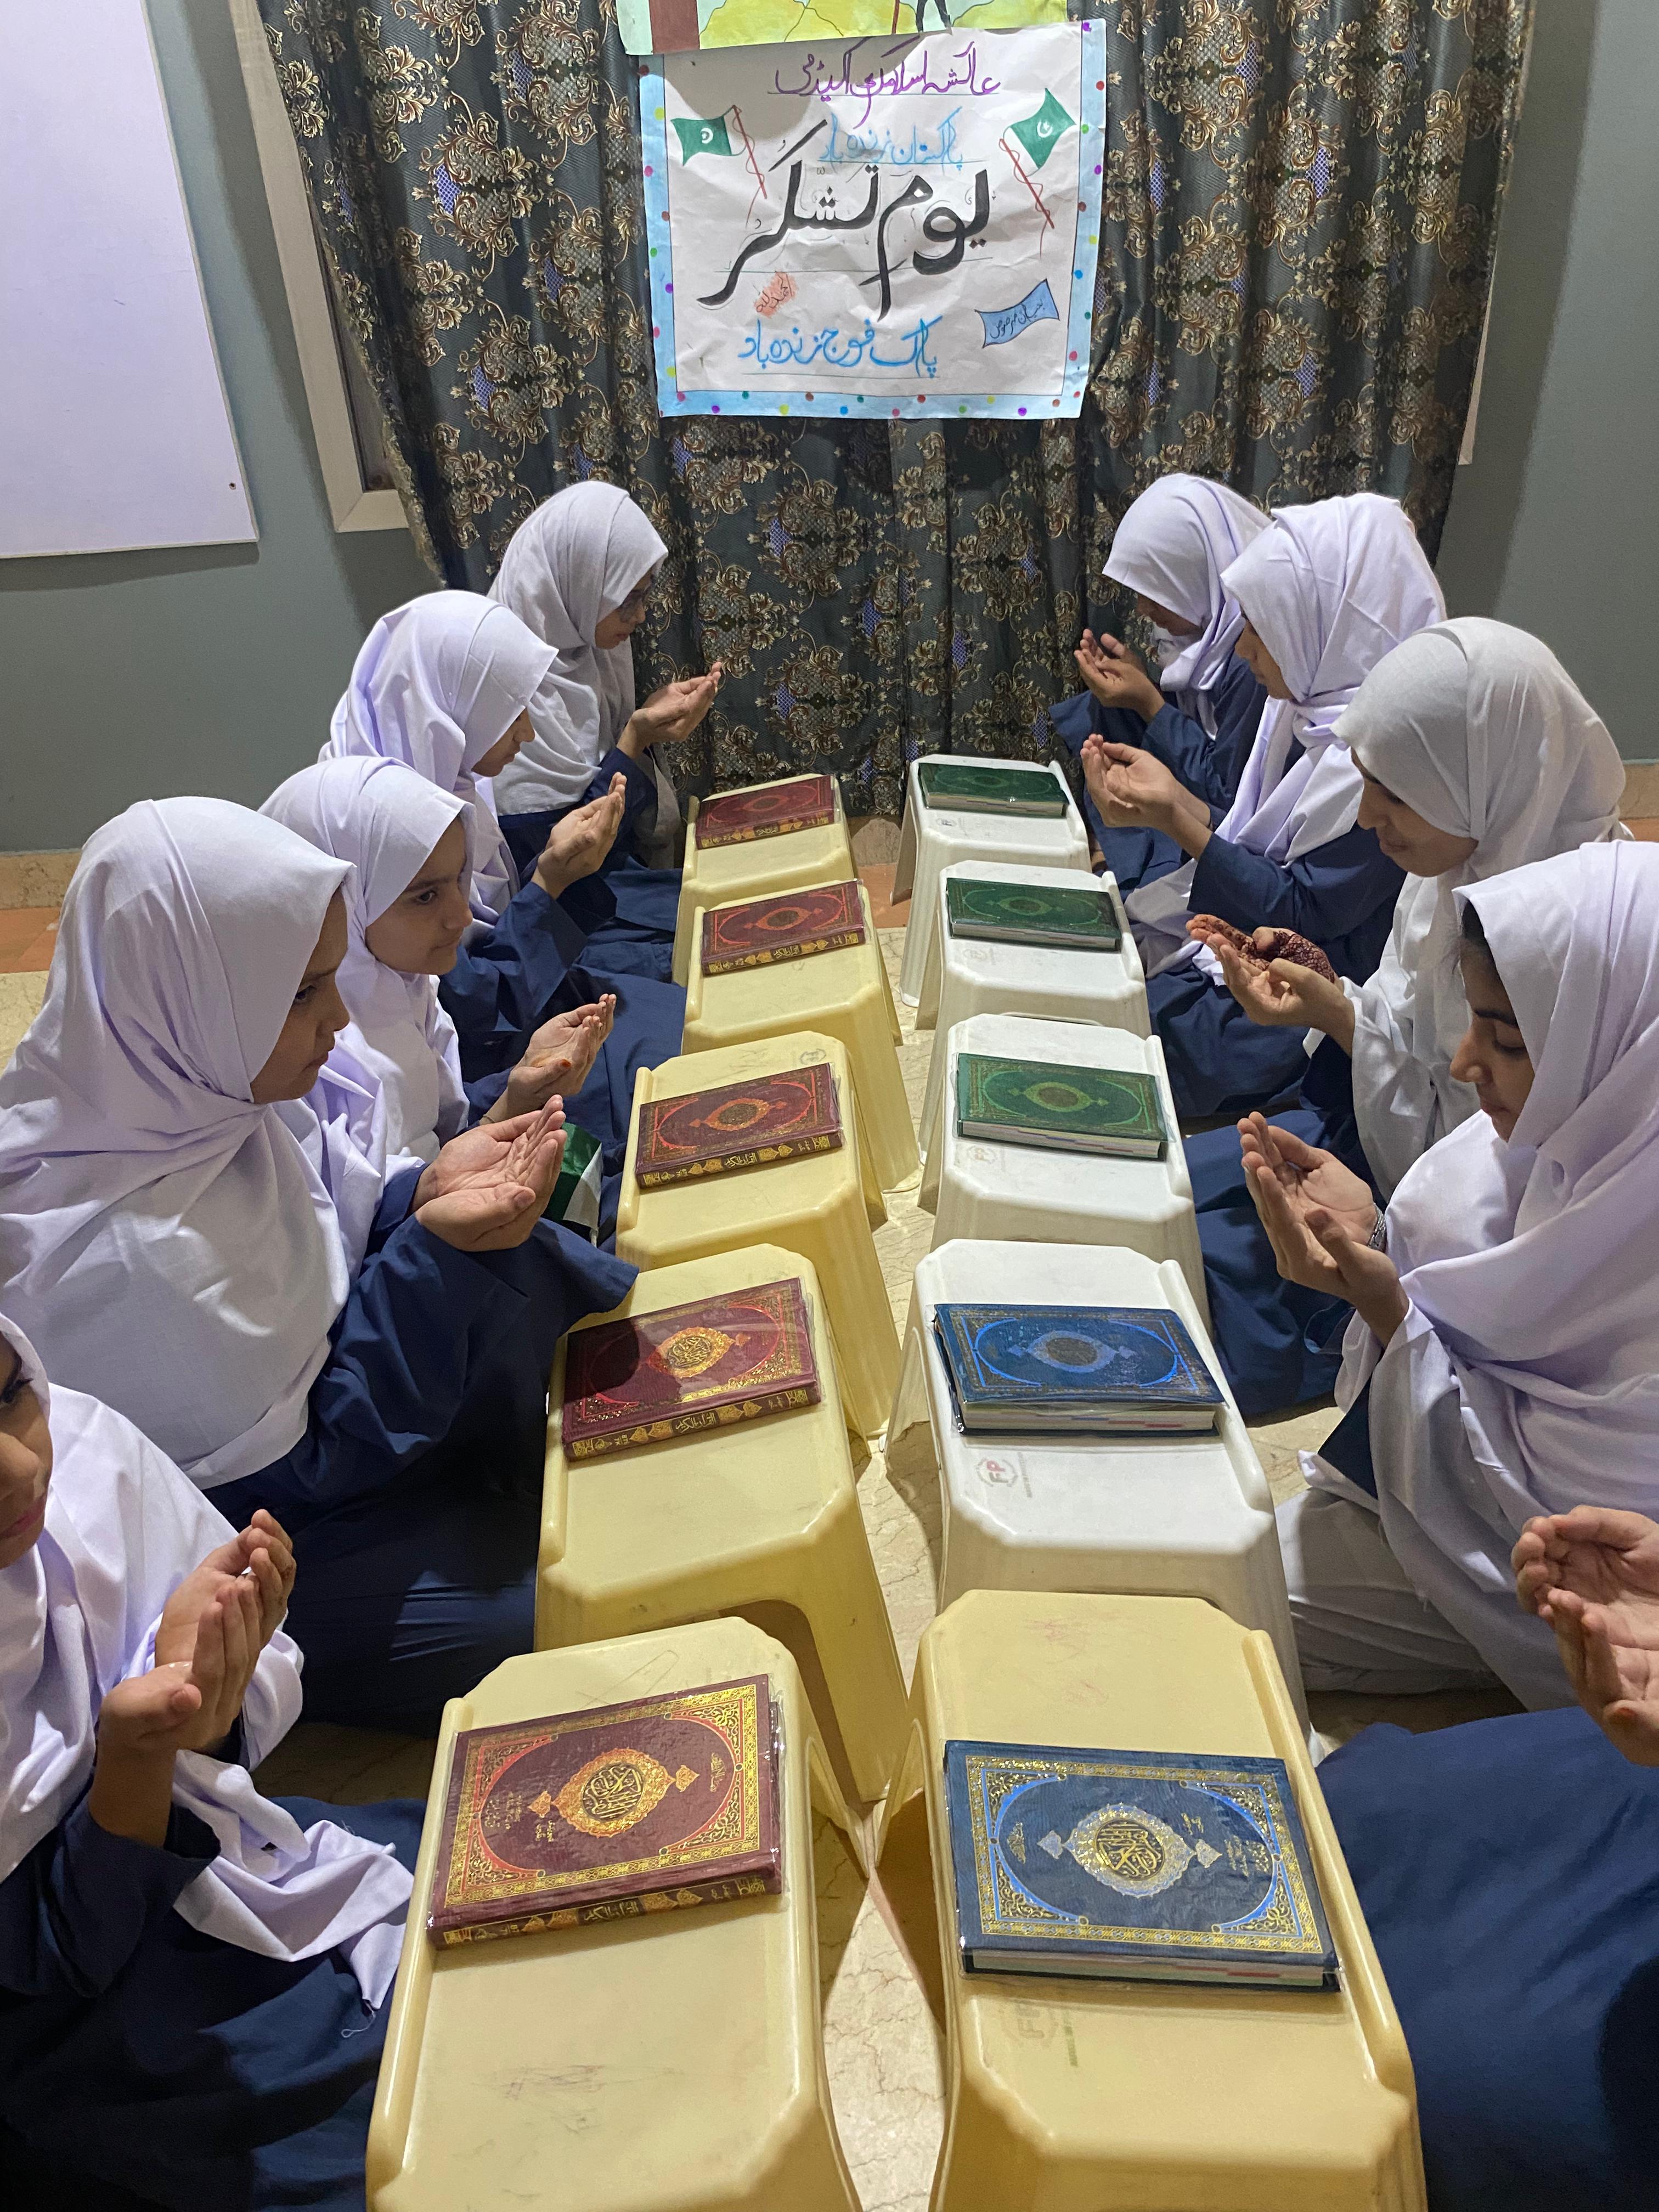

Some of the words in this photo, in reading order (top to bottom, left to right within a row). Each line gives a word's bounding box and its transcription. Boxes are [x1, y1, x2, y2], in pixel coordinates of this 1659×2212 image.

[696, 119, 879, 306] تشکر
[859, 168, 990, 323] یوم
[737, 318, 769, 369] باد
[820, 318, 875, 368] فوج
[870, 315, 944, 379] پاک
